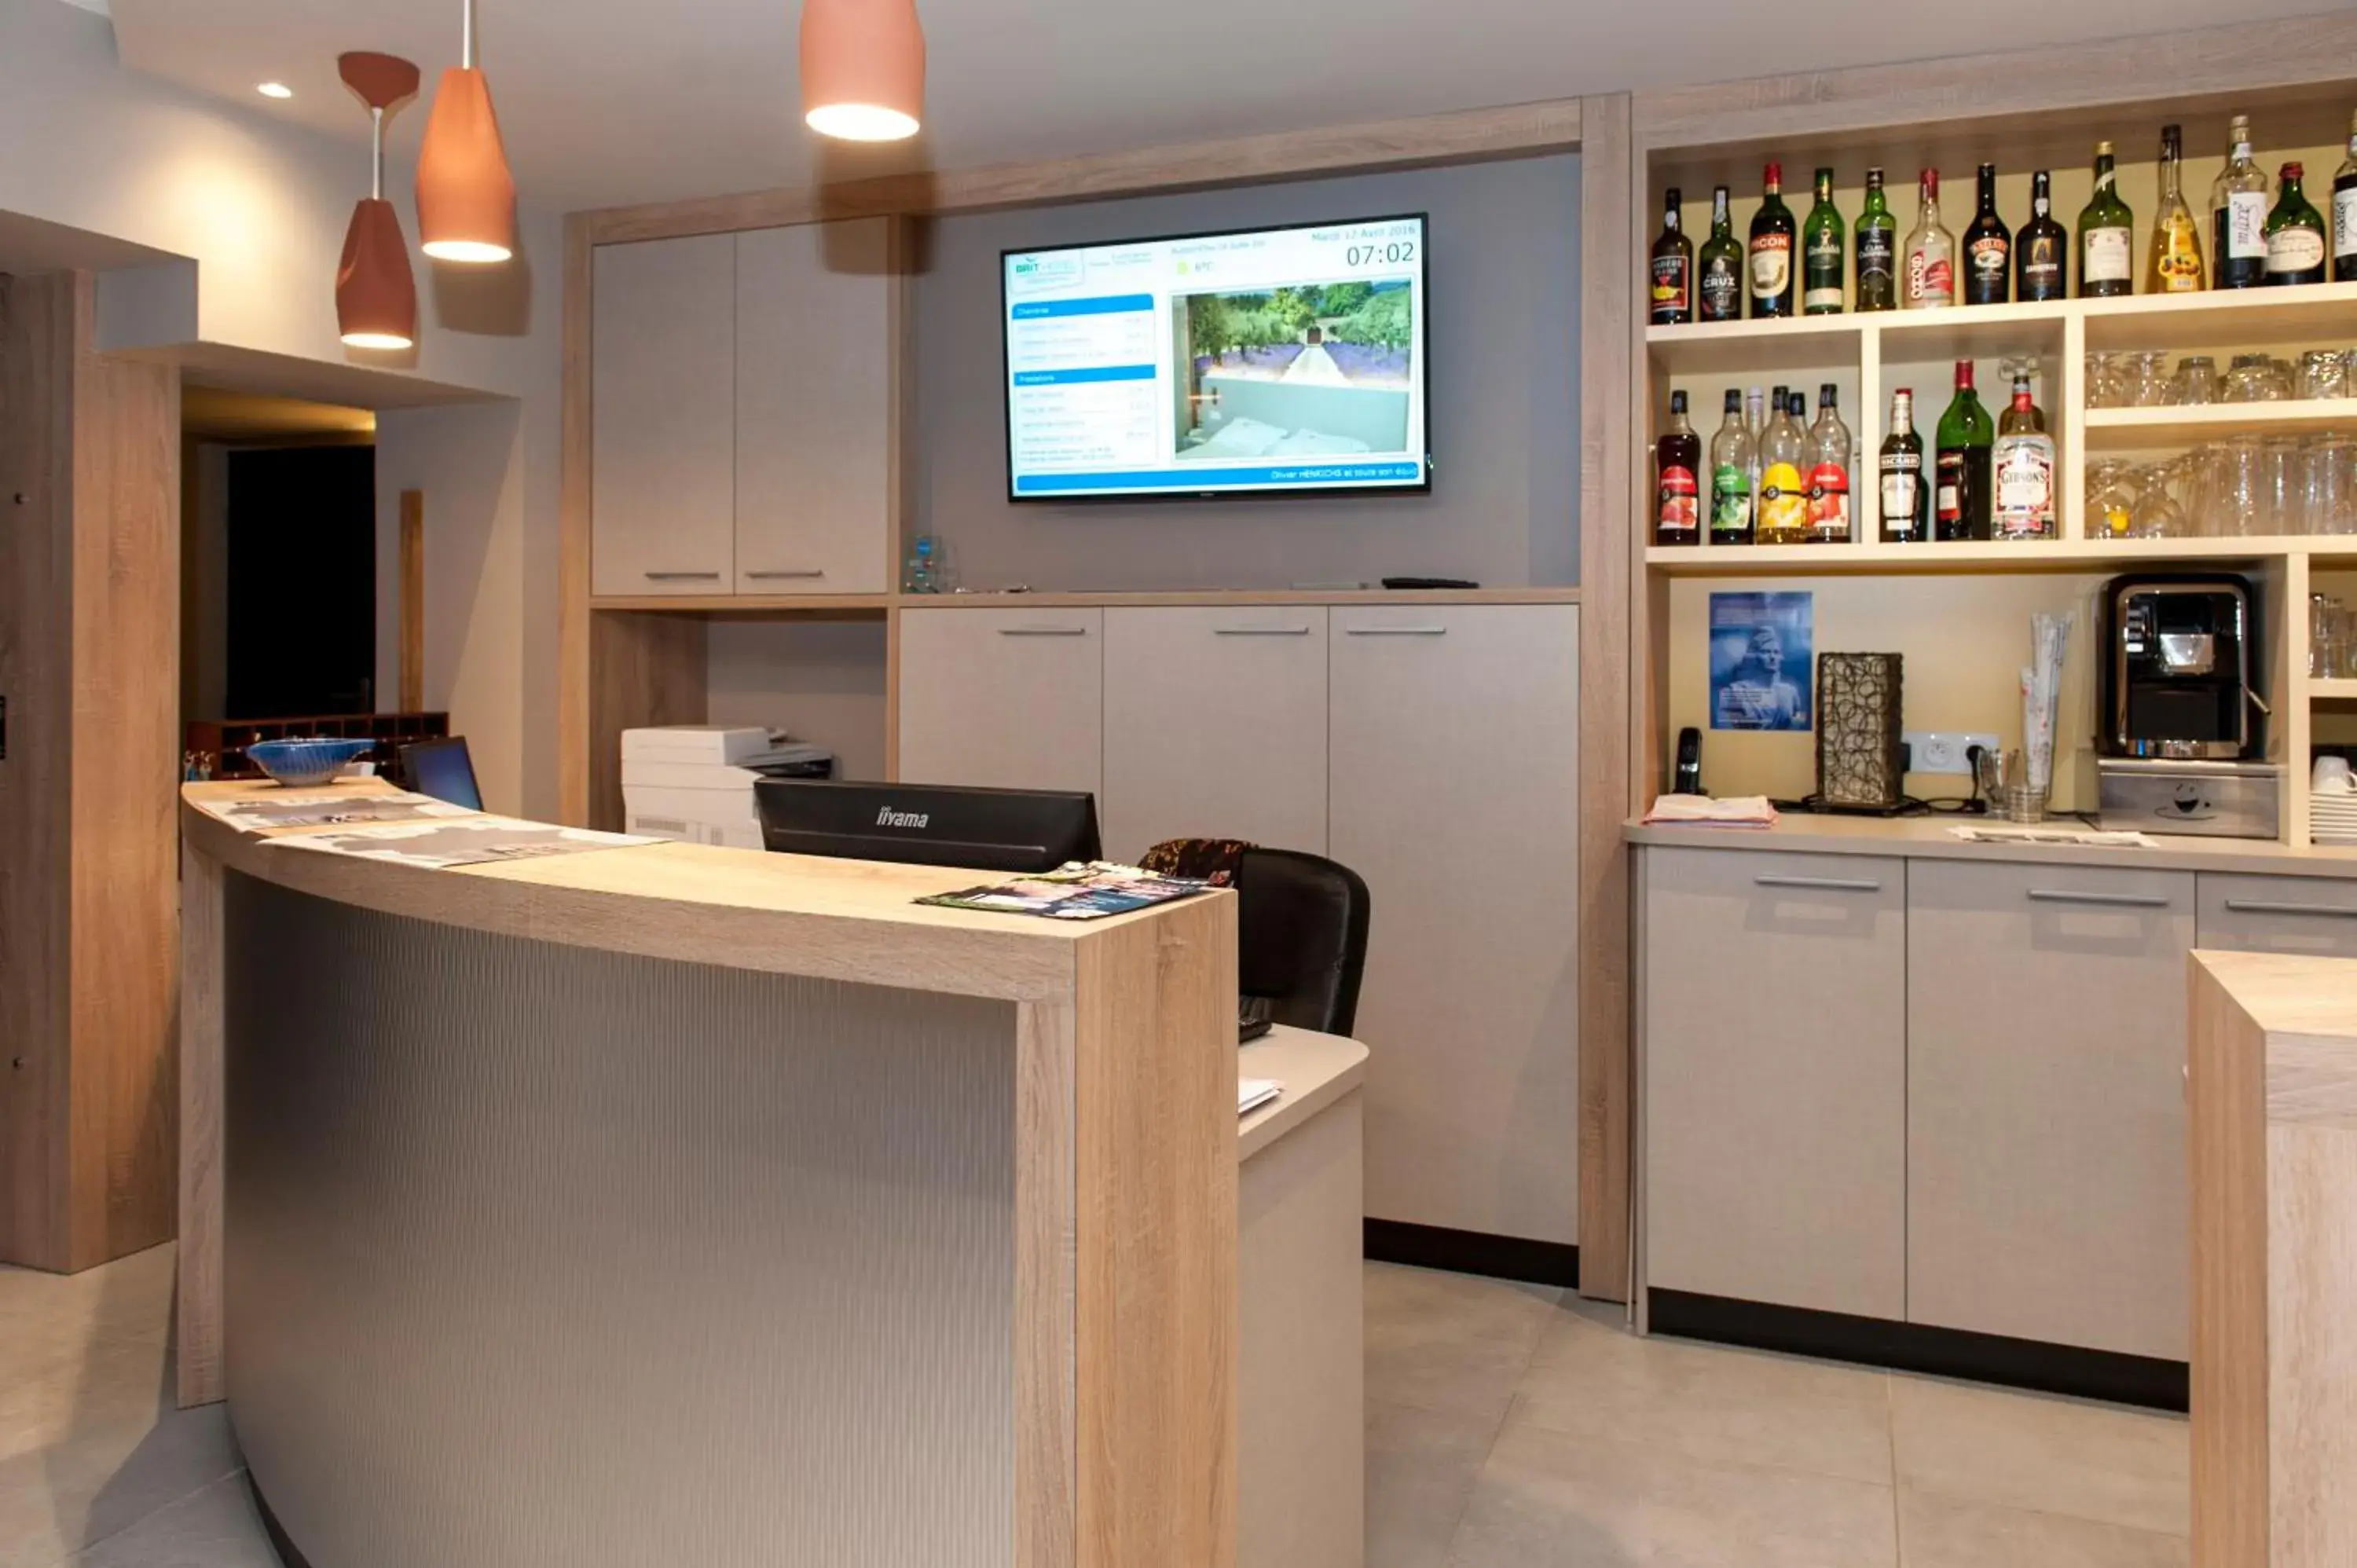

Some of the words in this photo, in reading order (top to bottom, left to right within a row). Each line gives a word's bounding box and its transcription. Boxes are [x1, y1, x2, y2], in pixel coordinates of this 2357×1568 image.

[1389, 225, 1416, 236] 2016
[1347, 241, 1414, 266] 07:02
[1703, 277, 1736, 288] CRUZ
[1911, 255, 1923, 299] SOHO
[876, 806, 929, 828] iiyama
